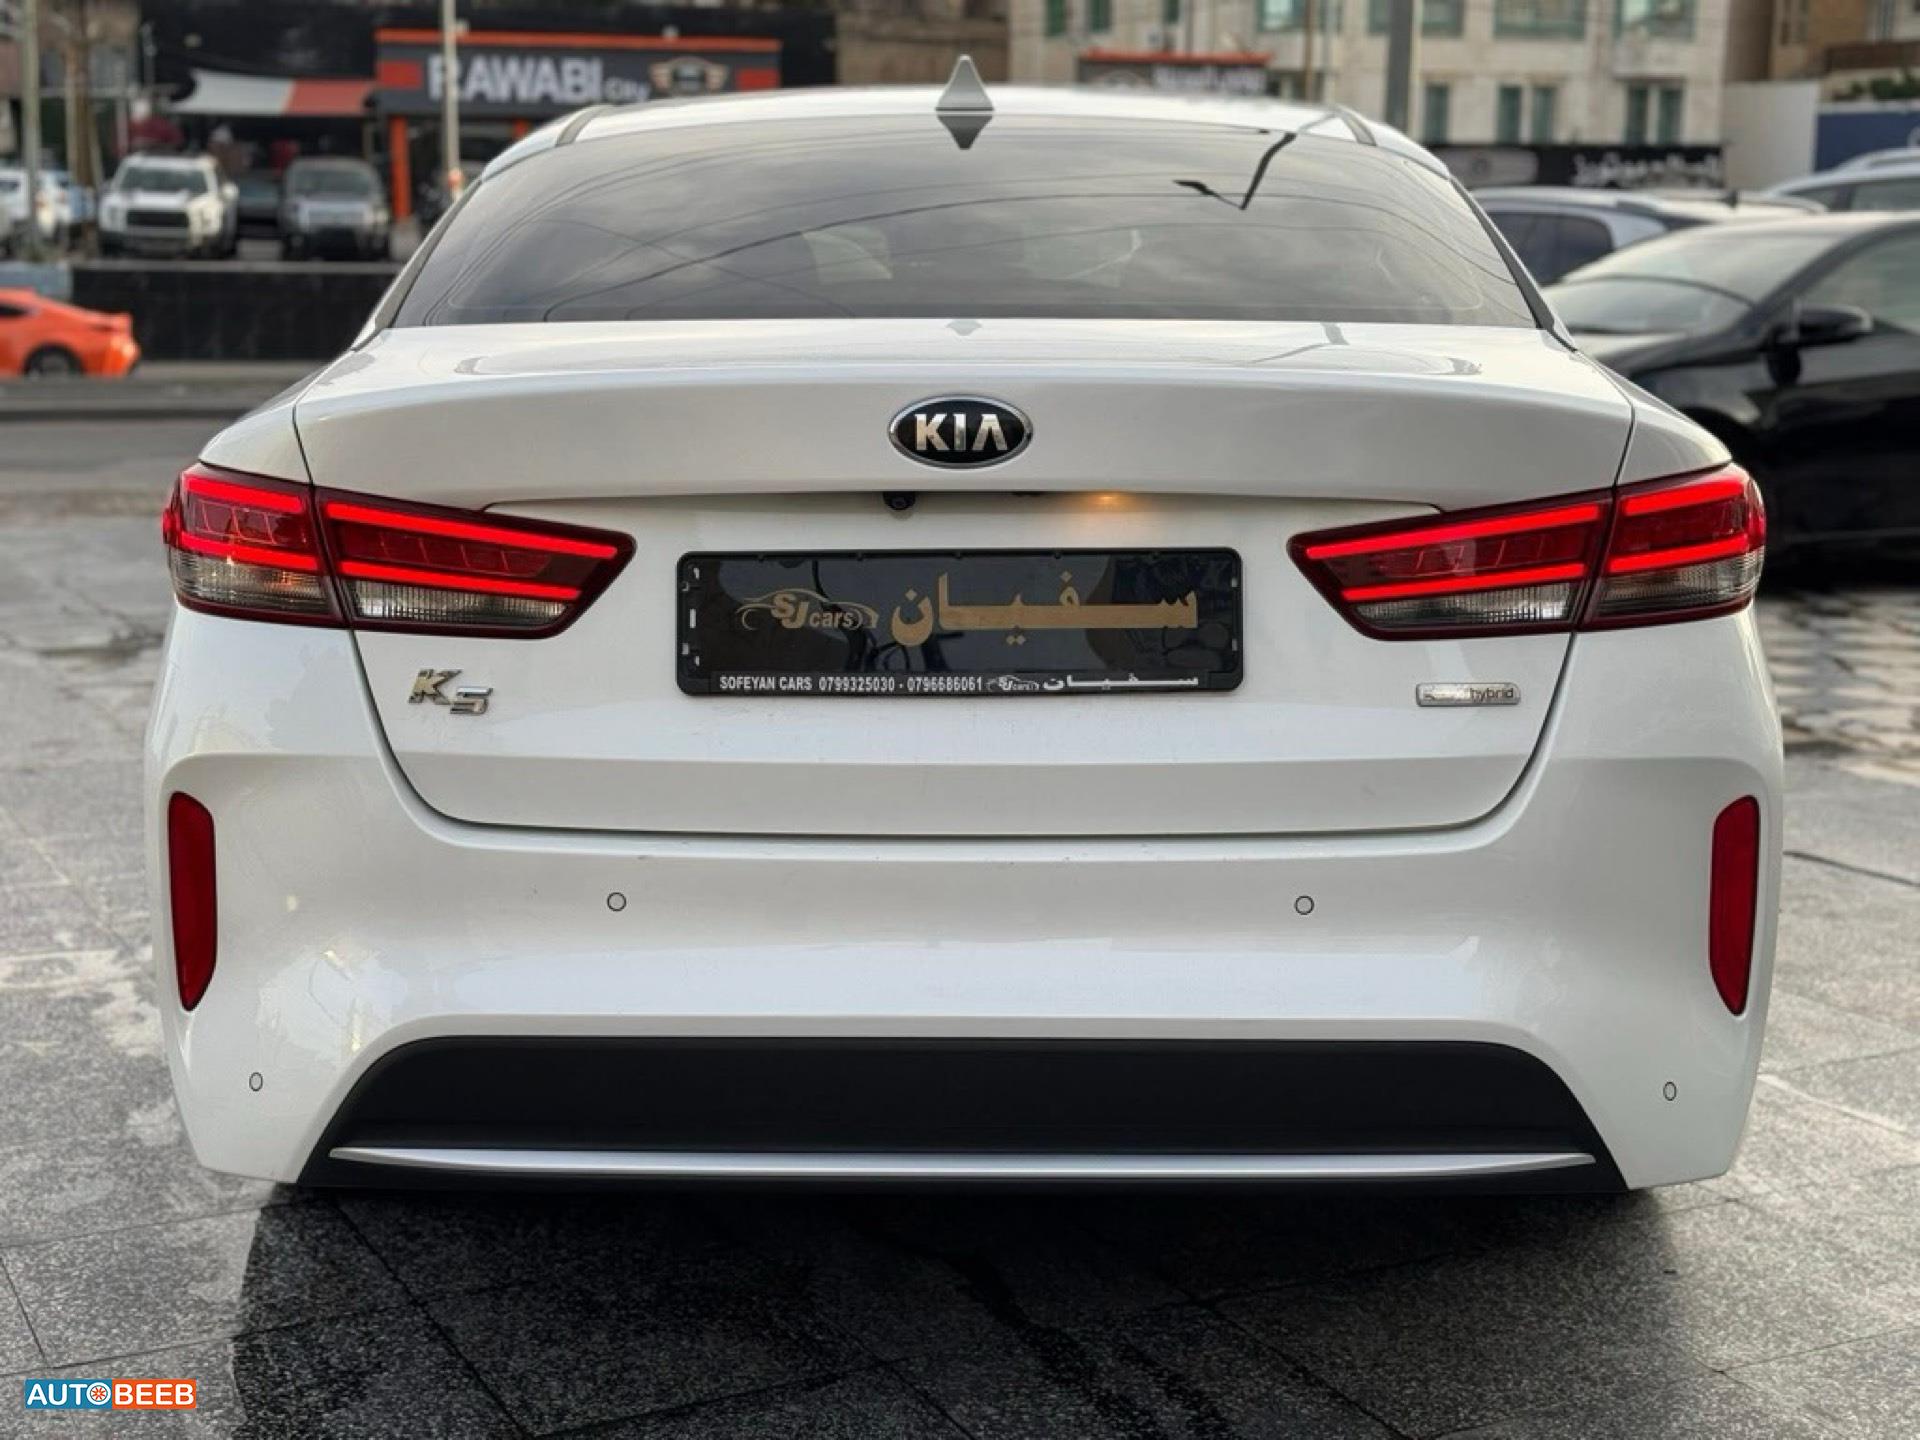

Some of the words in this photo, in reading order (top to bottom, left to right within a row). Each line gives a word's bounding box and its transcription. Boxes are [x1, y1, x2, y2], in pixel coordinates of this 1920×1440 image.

[427, 54, 606, 103] RAWABI
[914, 413, 1008, 451] KIA
[408, 668, 493, 715] K5
[719, 675, 775, 690] SOFEYAN
[779, 676, 813, 690] CARS
[1469, 687, 1514, 702] hybrid
